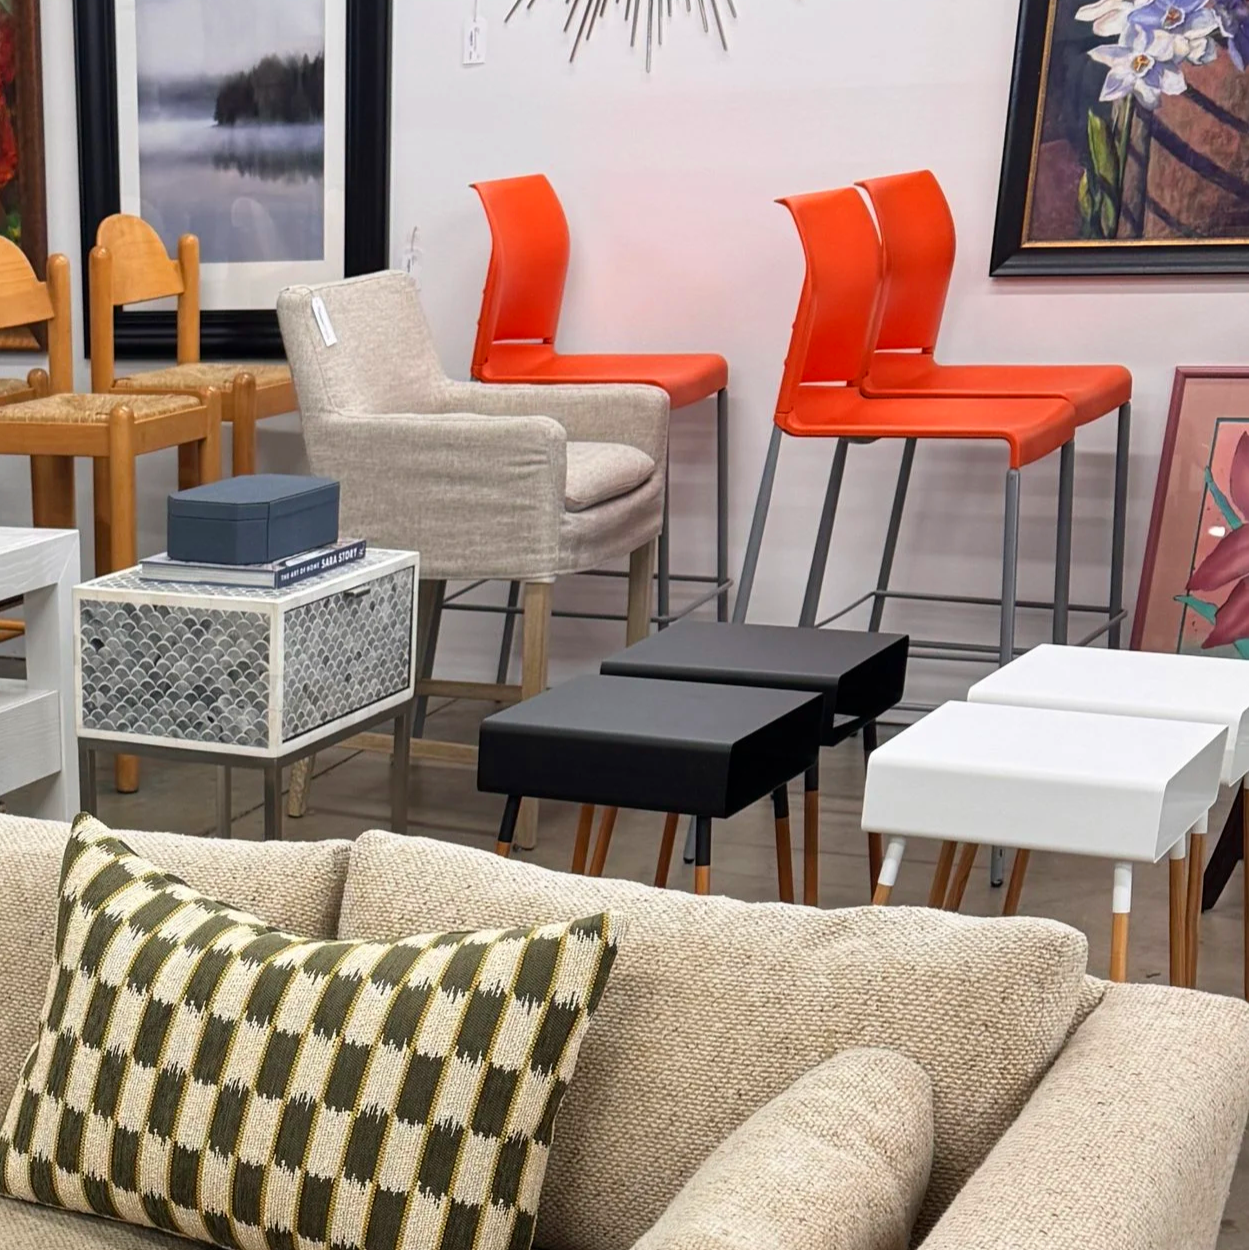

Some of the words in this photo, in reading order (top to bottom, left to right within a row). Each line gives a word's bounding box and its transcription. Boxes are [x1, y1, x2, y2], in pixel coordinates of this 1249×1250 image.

[290, 569, 300, 578] ART
[321, 555, 338, 569] SARA
[338, 547, 358, 563] STORY
